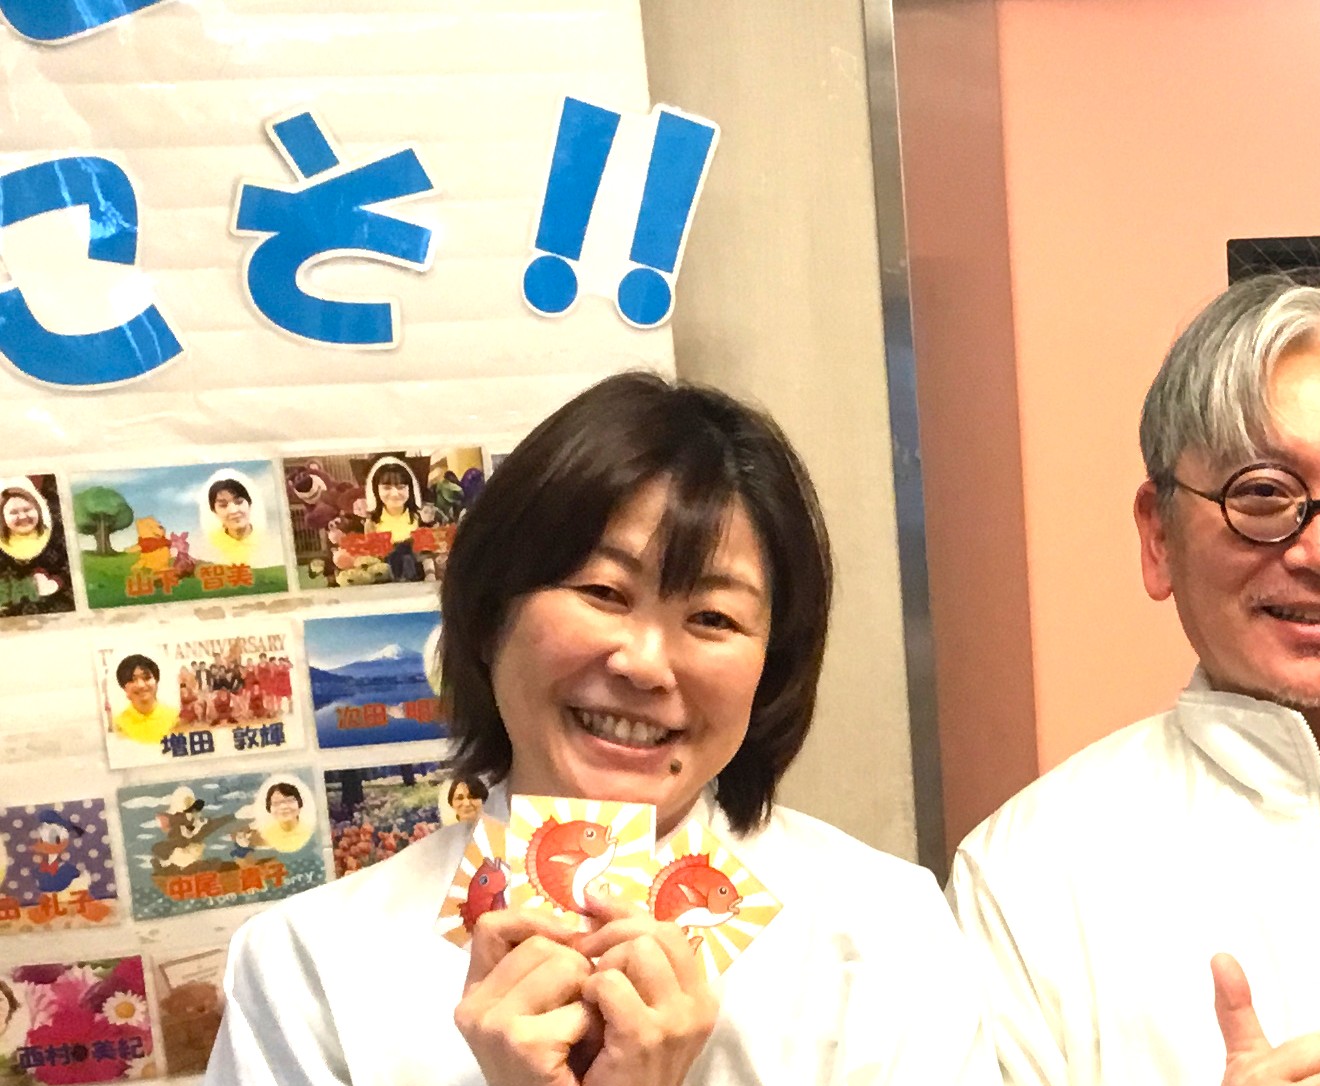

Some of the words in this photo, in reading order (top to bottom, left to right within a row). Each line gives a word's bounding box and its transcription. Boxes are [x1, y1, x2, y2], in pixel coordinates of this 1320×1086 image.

[126, 568, 180, 597] 山下
[200, 563, 253, 591] 智美
[160, 731, 215, 757] 増田
[168, 872, 222, 900] 中尾
